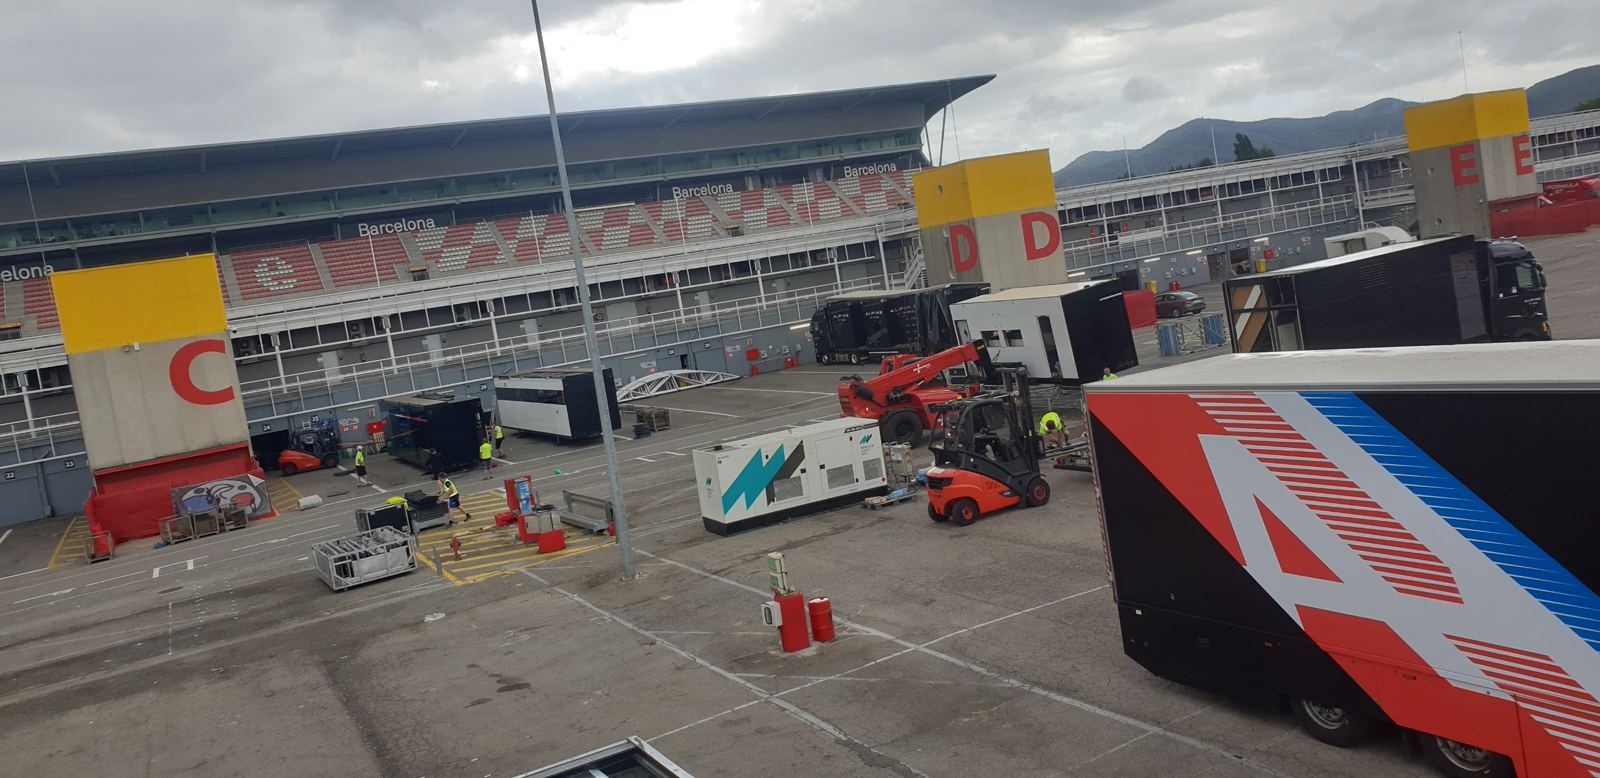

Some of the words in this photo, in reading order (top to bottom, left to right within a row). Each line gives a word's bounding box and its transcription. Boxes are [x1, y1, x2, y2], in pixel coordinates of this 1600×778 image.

[843, 162, 897, 178] Barcelona
[1449, 143, 1480, 187] E
[1512, 134, 1535, 176] E
[672, 183, 733, 199] Barcelona
[358, 217, 436, 238] Barcelona
[949, 224, 979, 273] D
[1020, 211, 1061, 261] D
[169, 339, 235, 406] C
